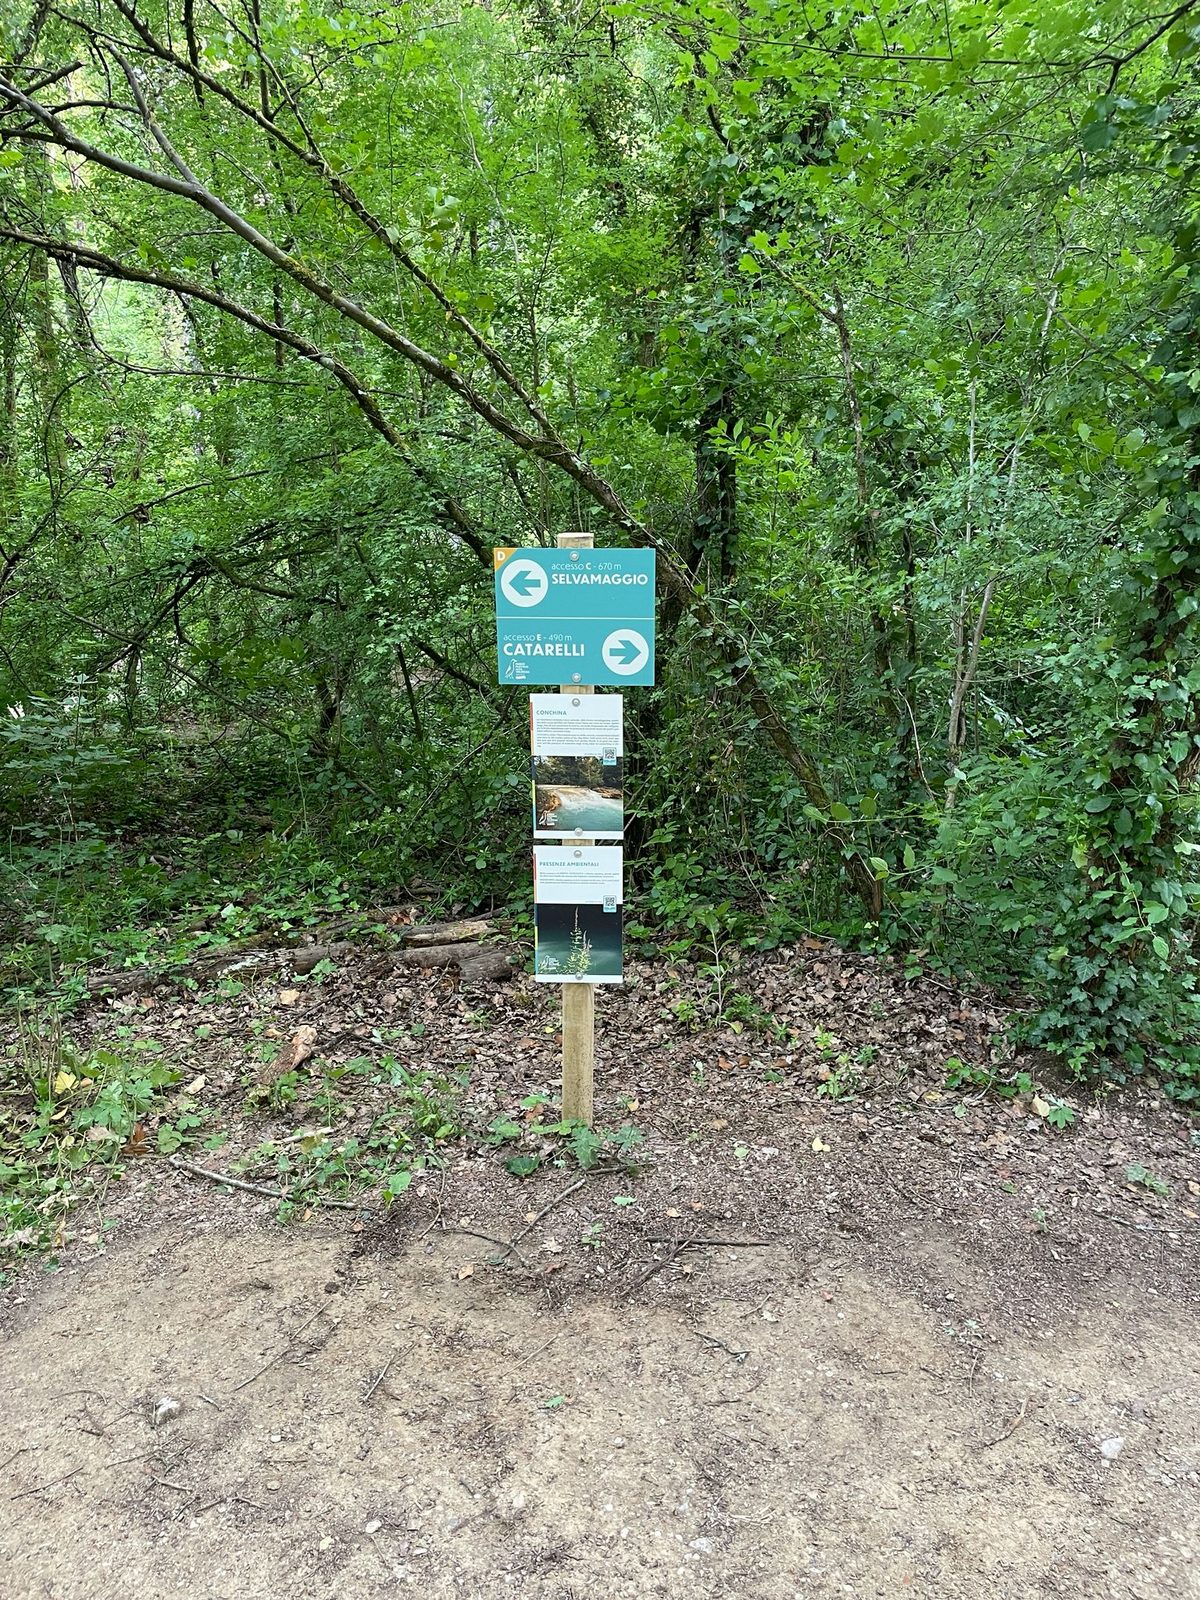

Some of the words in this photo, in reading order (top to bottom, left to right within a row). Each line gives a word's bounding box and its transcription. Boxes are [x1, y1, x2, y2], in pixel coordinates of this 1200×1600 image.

[496, 551, 506, 561] D
[598, 562, 613, 570] 670
[551, 573, 648, 585] SELVAMAGGIO
[503, 643, 585, 657] CATARELLI
